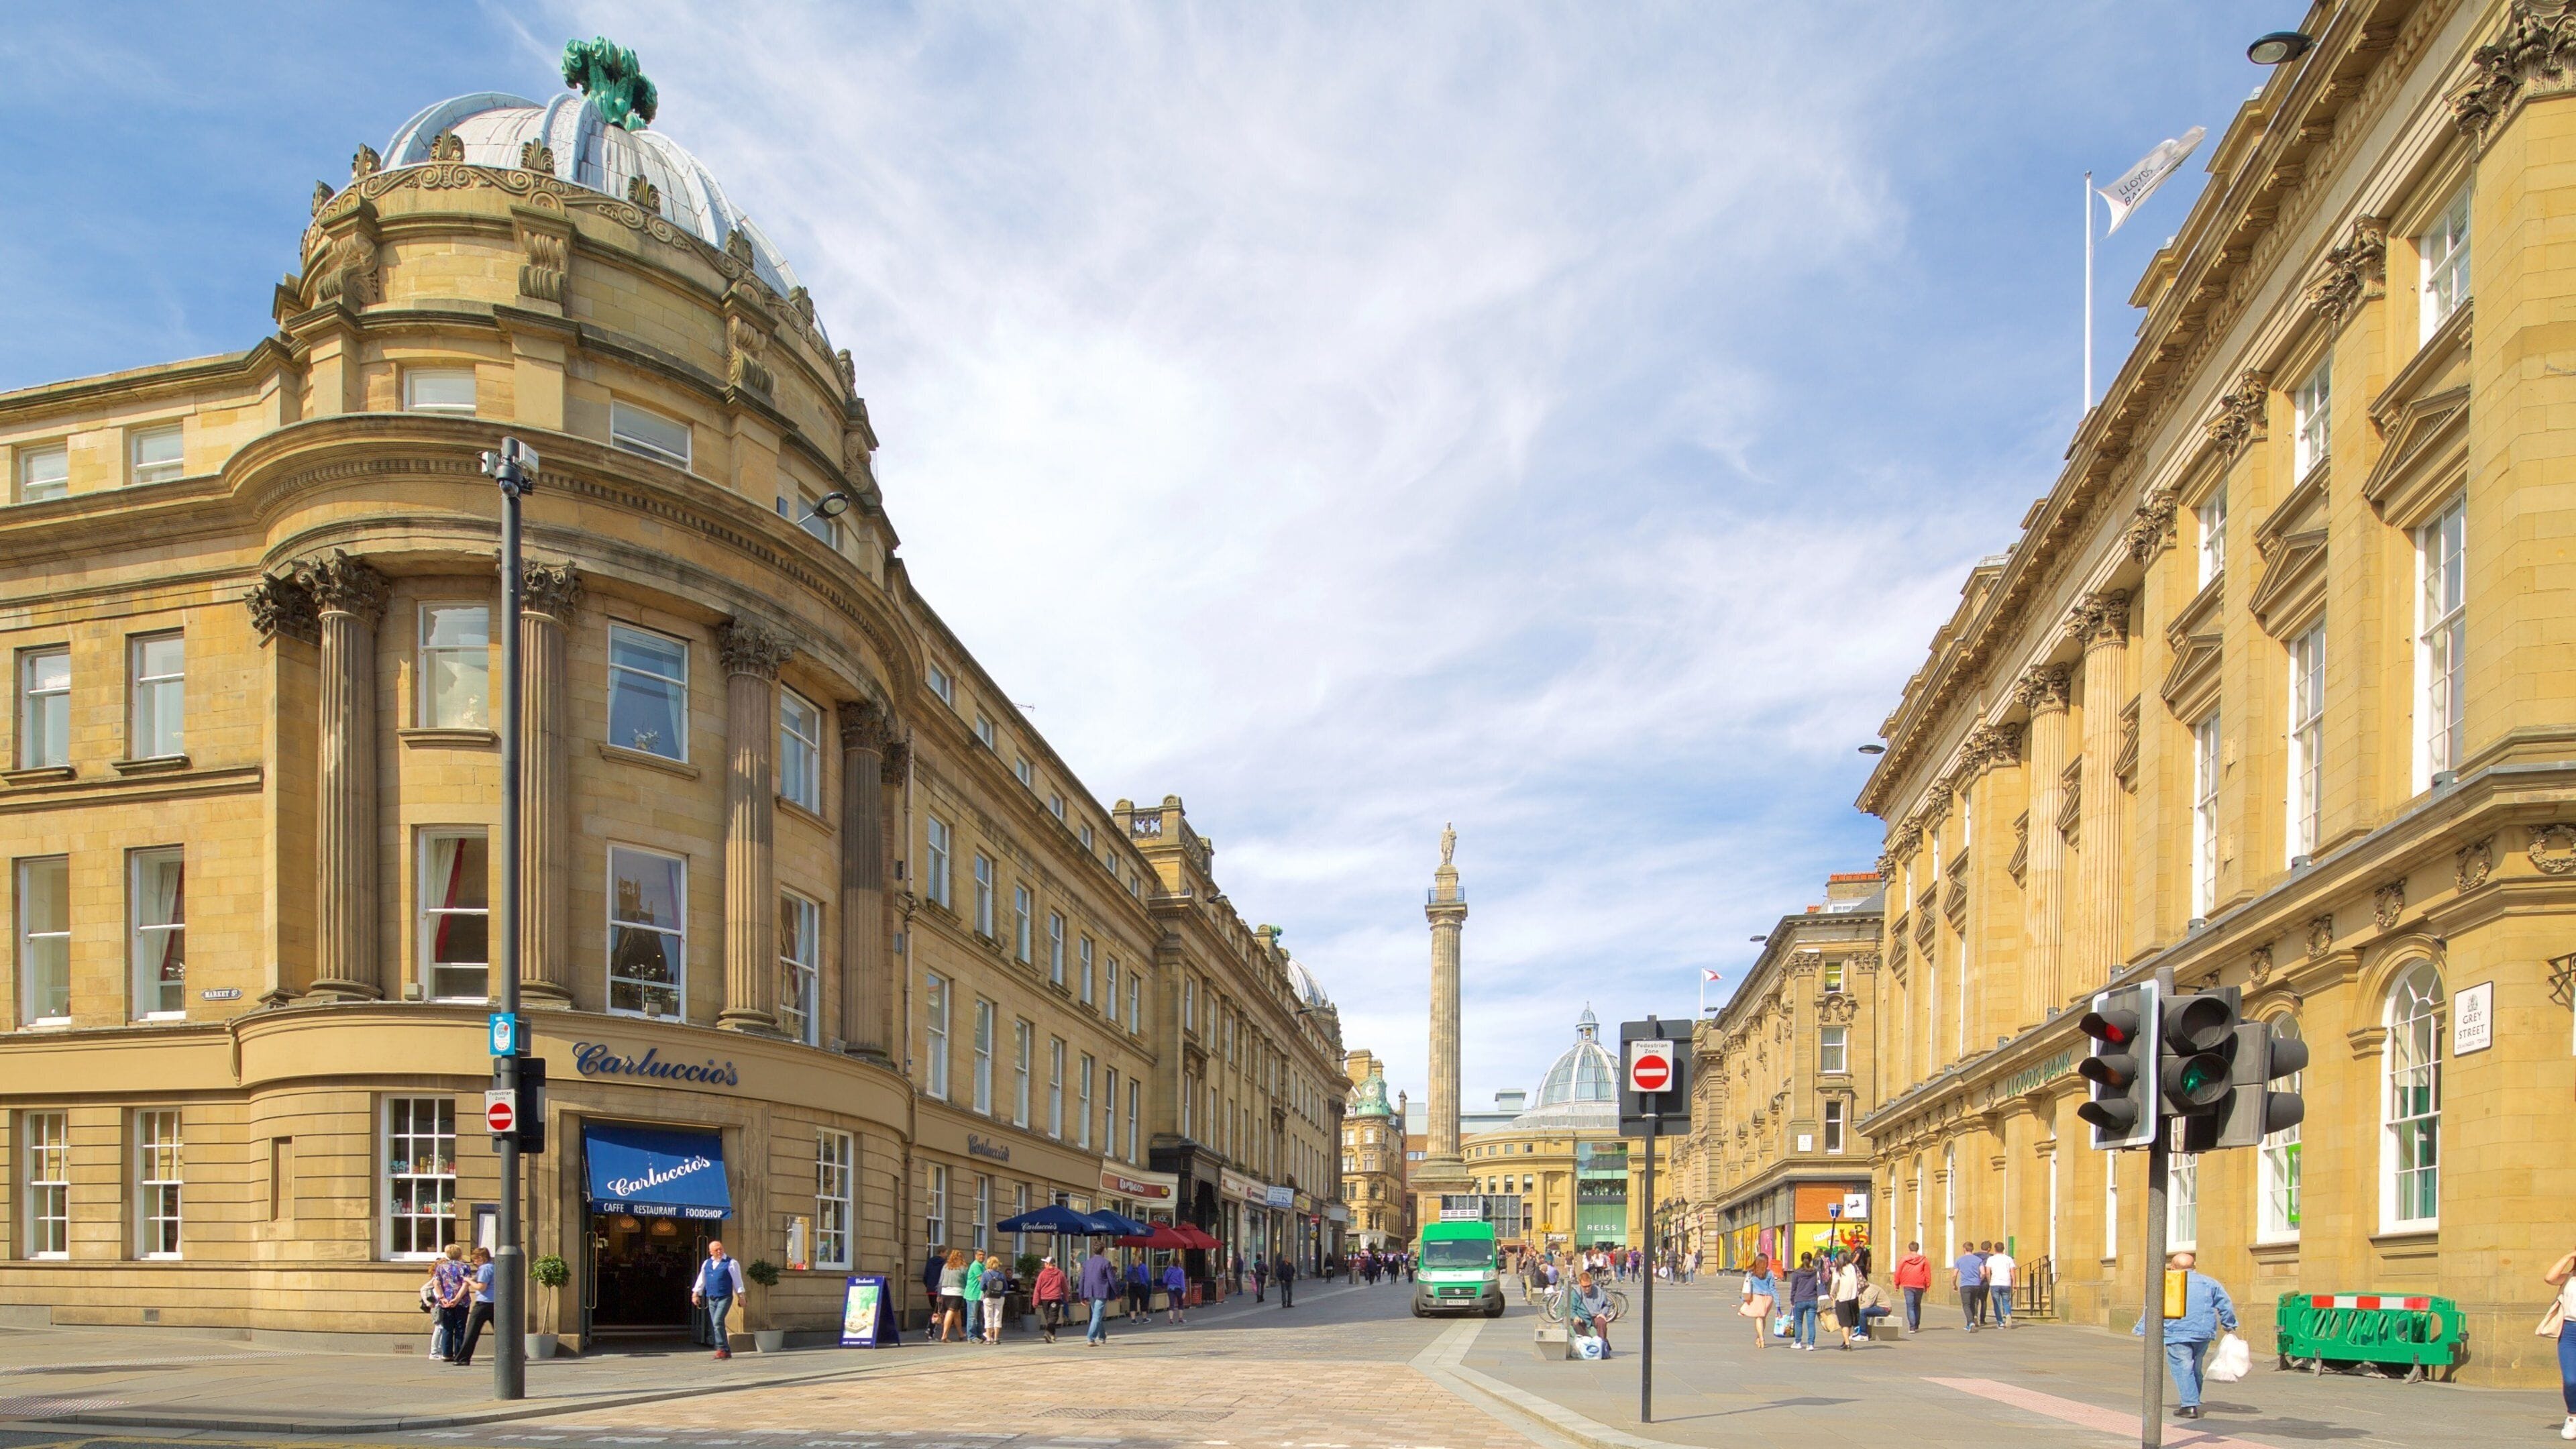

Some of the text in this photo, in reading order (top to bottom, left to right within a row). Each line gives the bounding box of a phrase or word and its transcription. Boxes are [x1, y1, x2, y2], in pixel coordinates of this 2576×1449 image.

[2118, 168, 2153, 196] LLOYDS
[205, 990, 229, 998] MARKET
[2463, 1010, 2482, 1024] GREY
[2459, 1024, 2485, 1040] STREET
[572, 1042, 738, 1086] Carluccio's
[2006, 1049, 2072, 1098] LLOYDS BANK
[968, 1134, 1010, 1162] Carluccio's
[607, 1155, 711, 1196] Carluccio's
[604, 1203, 722, 1218] CAFFE RESTAURANT FOODSHOP
[1021, 1222, 1058, 1231] Carluccio's
